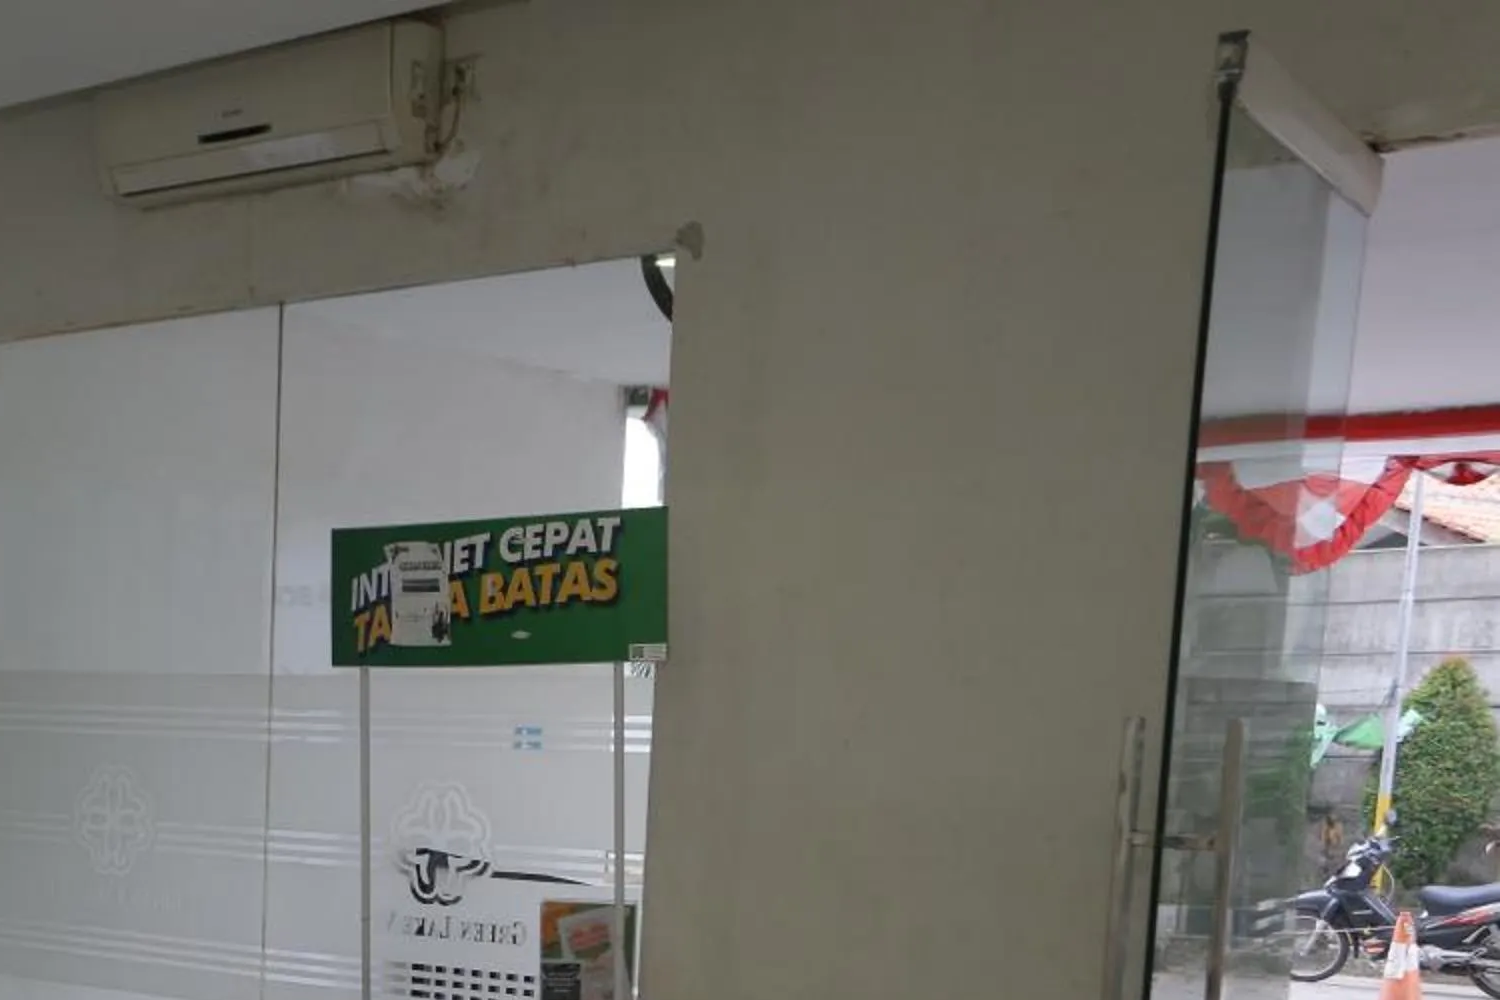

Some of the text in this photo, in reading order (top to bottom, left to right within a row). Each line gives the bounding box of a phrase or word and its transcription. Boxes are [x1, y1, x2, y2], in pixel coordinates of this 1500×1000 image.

[351, 516, 621, 612] INTET CEPAT
[354, 557, 620, 653] TAA BATAS
